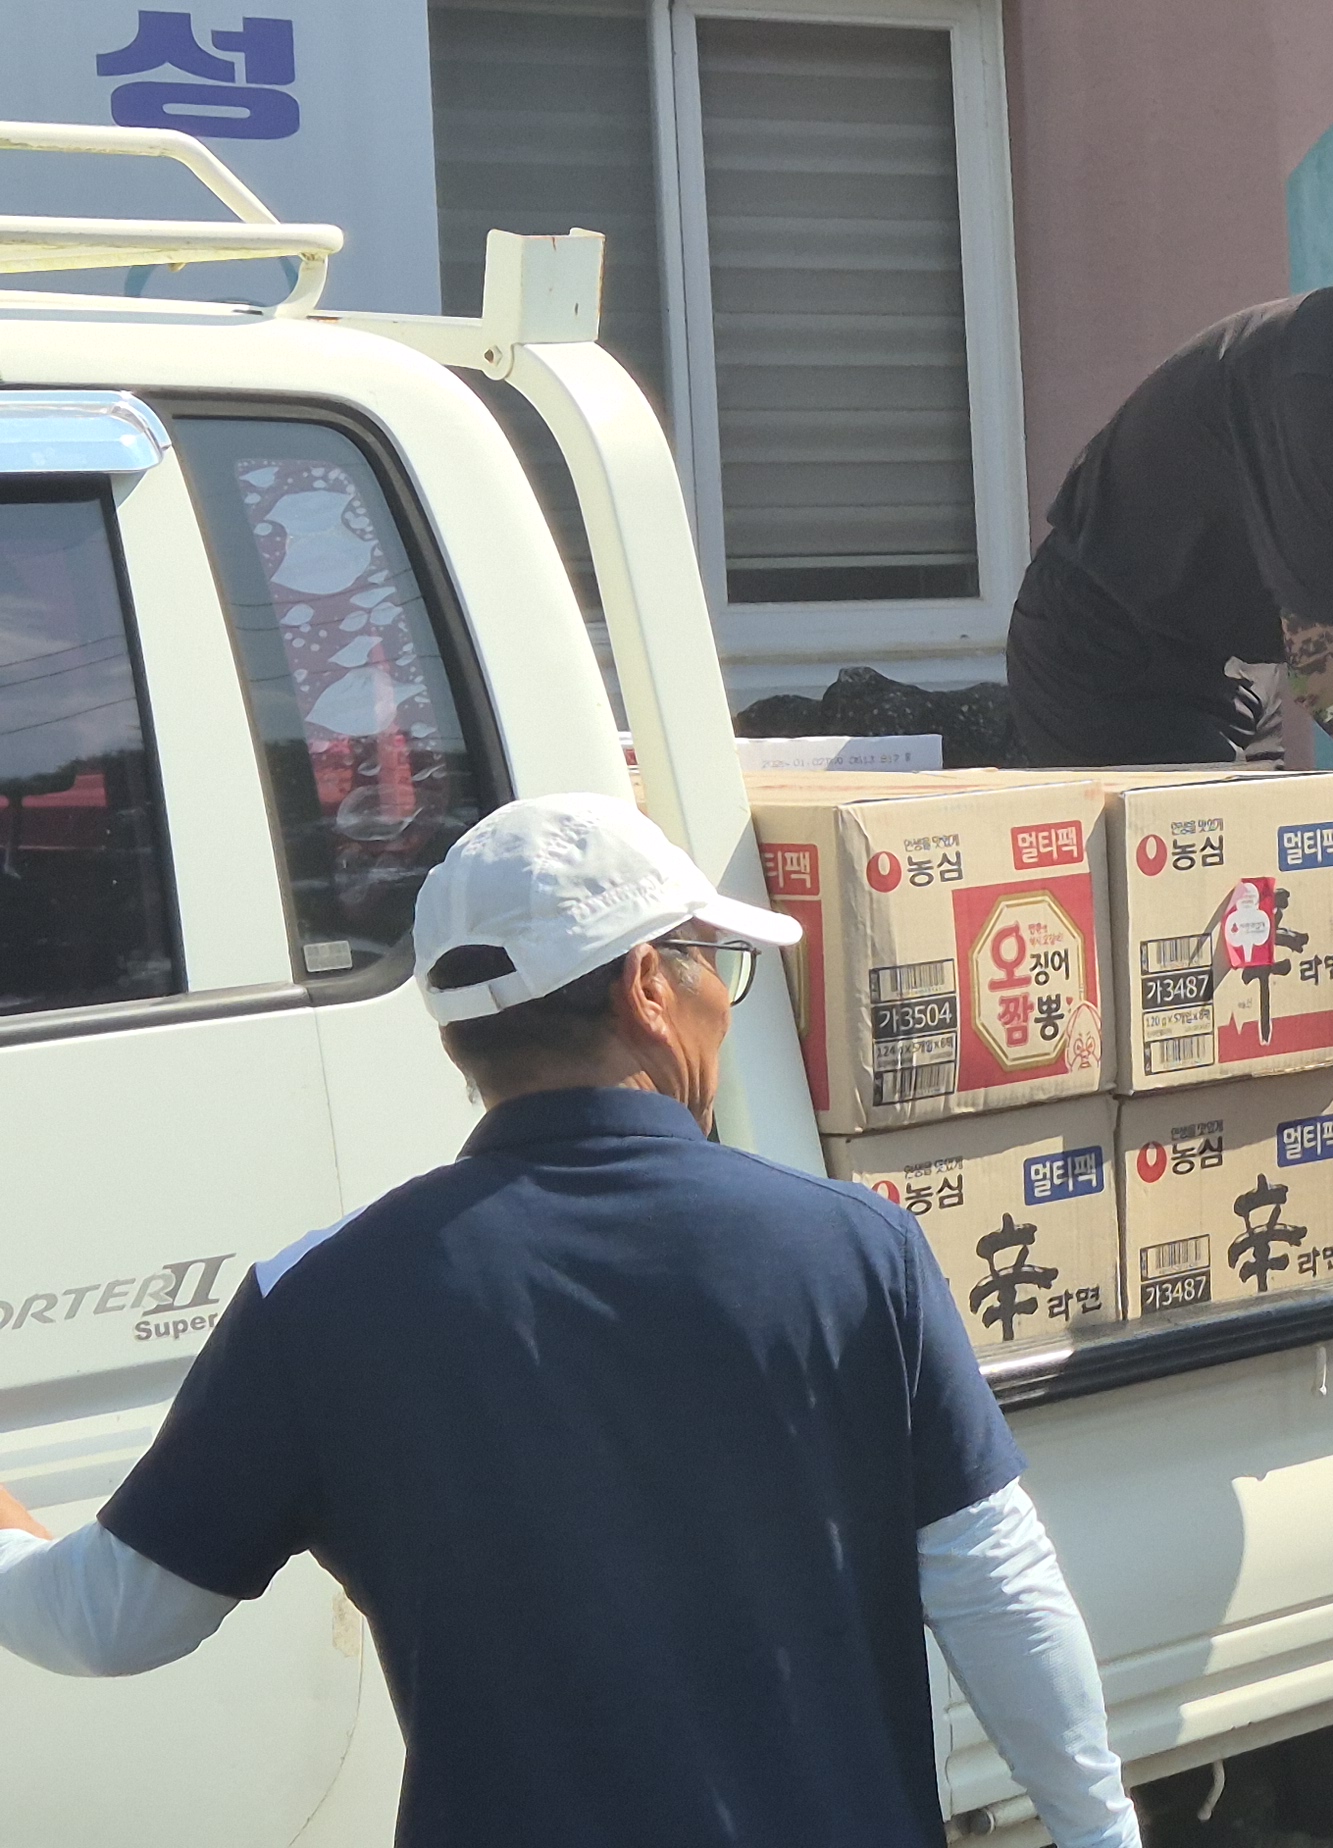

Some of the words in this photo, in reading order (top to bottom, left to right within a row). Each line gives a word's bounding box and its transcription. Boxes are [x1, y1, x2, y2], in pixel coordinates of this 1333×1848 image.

[96, 10, 300, 140] 성
[1016, 826, 1079, 864] 멀티팩
[1171, 834, 1224, 871] 농심
[906, 850, 964, 888] 농심
[1146, 974, 1210, 1005] 가3487
[878, 1001, 953, 1034] 가3504
[997, 991, 1065, 1048] 짬뽕
[1029, 1152, 1099, 1198] 멀티팩
[1171, 1135, 1224, 1176] 농심
[904, 1173, 964, 1216] 농심
[1228, 1173, 1308, 1292] 辛
[969, 1212, 1059, 1341] 辛
[1047, 1283, 1103, 1322] 라면
[1145, 1275, 1208, 1310] 가3487
[134, 1311, 219, 1341] Super
